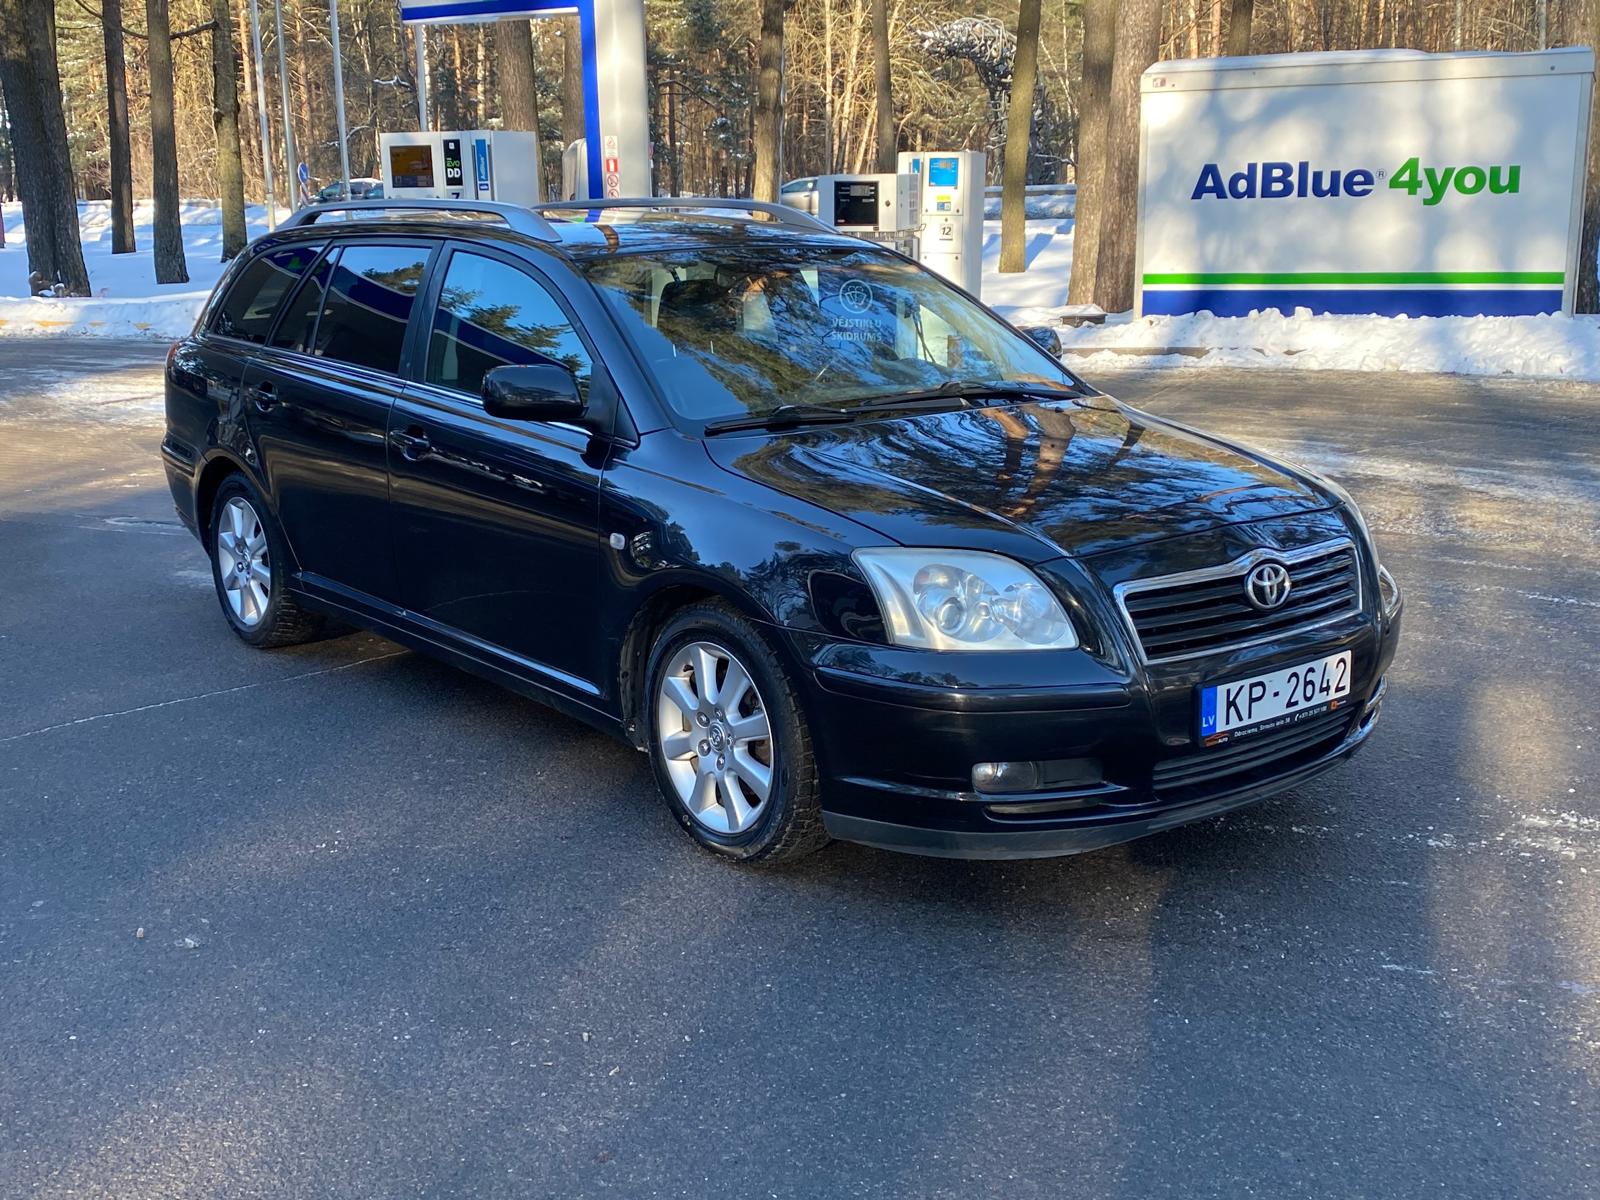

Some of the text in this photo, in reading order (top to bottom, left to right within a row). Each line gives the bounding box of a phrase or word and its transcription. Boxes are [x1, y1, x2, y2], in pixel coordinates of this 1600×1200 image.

[447, 168, 461, 178] DD
[1388, 157, 1521, 206] 4you
[942, 227, 952, 236] 12
[1202, 714, 1215, 728] LV
